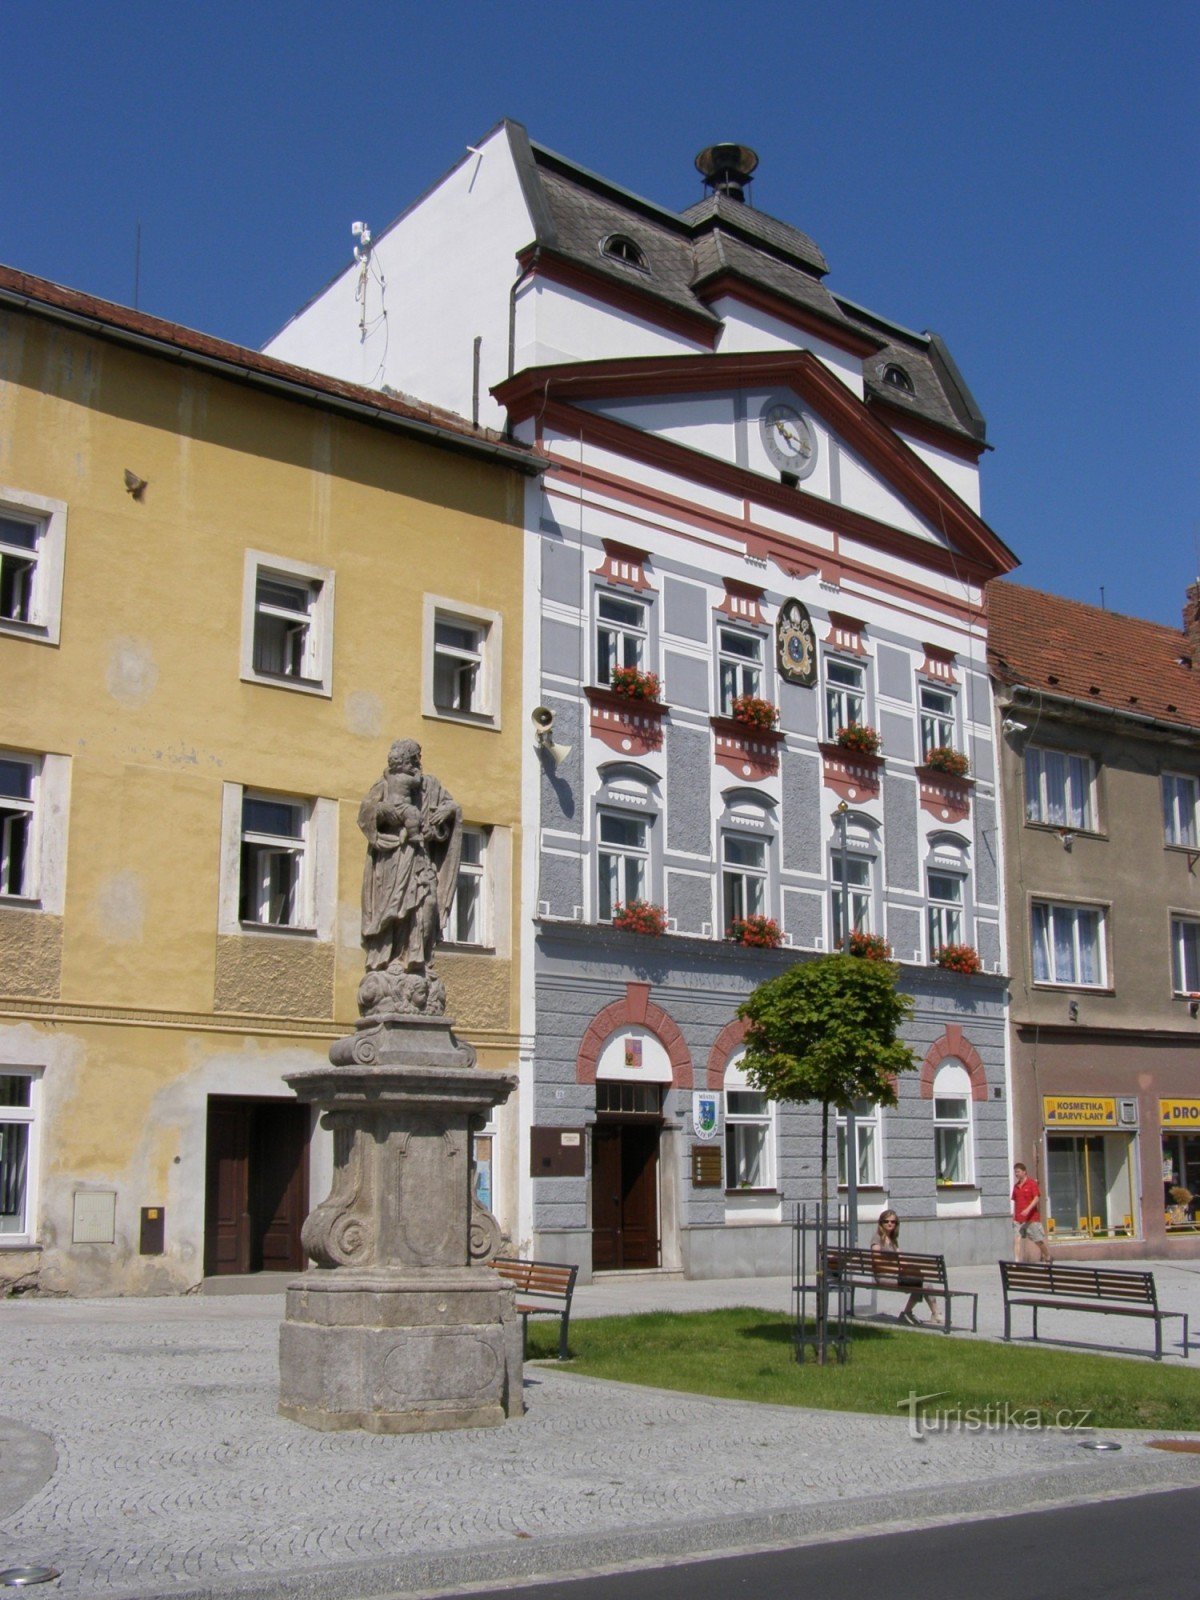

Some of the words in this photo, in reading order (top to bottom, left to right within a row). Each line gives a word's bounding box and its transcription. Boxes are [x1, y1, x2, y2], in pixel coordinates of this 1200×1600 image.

[1057, 1102, 1103, 1110] KOSMETIKA
[1057, 1112, 1103, 1120] BARVY-LAKY
[1173, 1106, 1200, 1119] DRO
